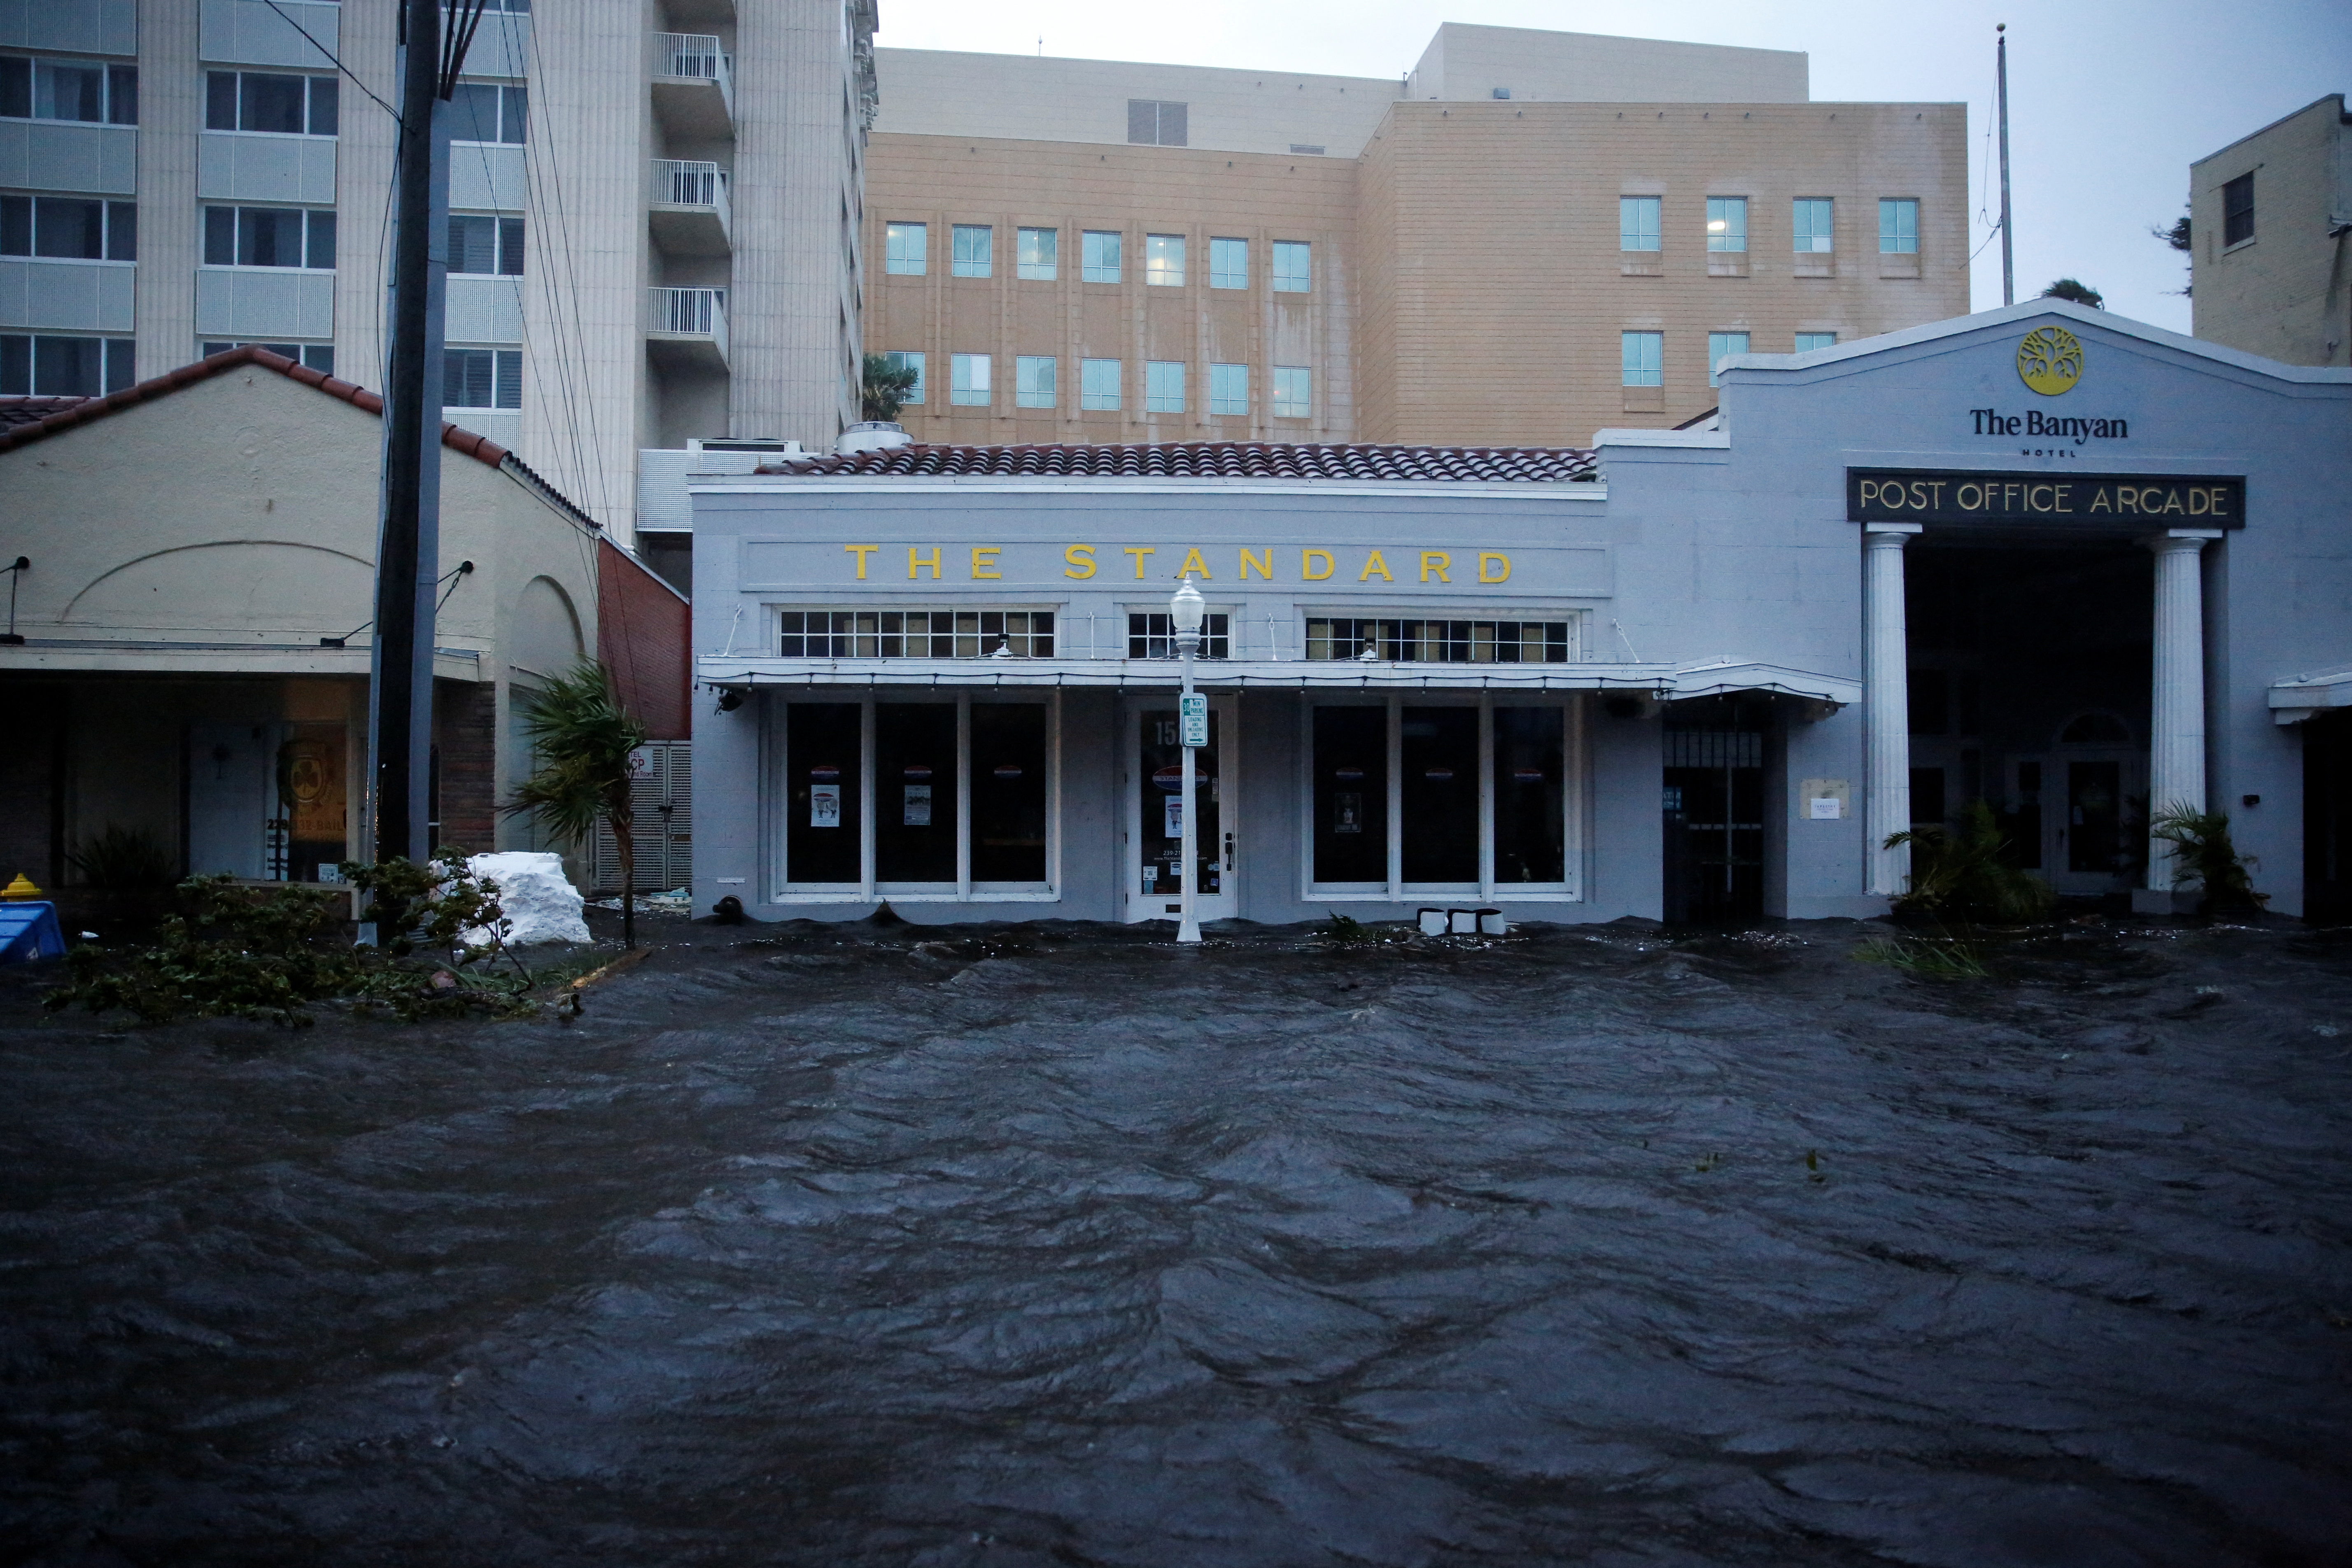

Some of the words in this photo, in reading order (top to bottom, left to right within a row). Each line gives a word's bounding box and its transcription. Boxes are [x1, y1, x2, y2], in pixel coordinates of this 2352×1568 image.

[1970, 409, 2021, 436] The
[2026, 410, 2128, 445] Banyan
[2022, 449, 2076, 457] HOTEL
[1860, 480, 1946, 510] POST
[1957, 482, 2073, 513] OFFICE
[2090, 487, 2227, 515] ARCADE
[844, 544, 1002, 580] THE
[1064, 544, 1511, 584] STANDARD
[1183, 703, 1190, 712] 30
